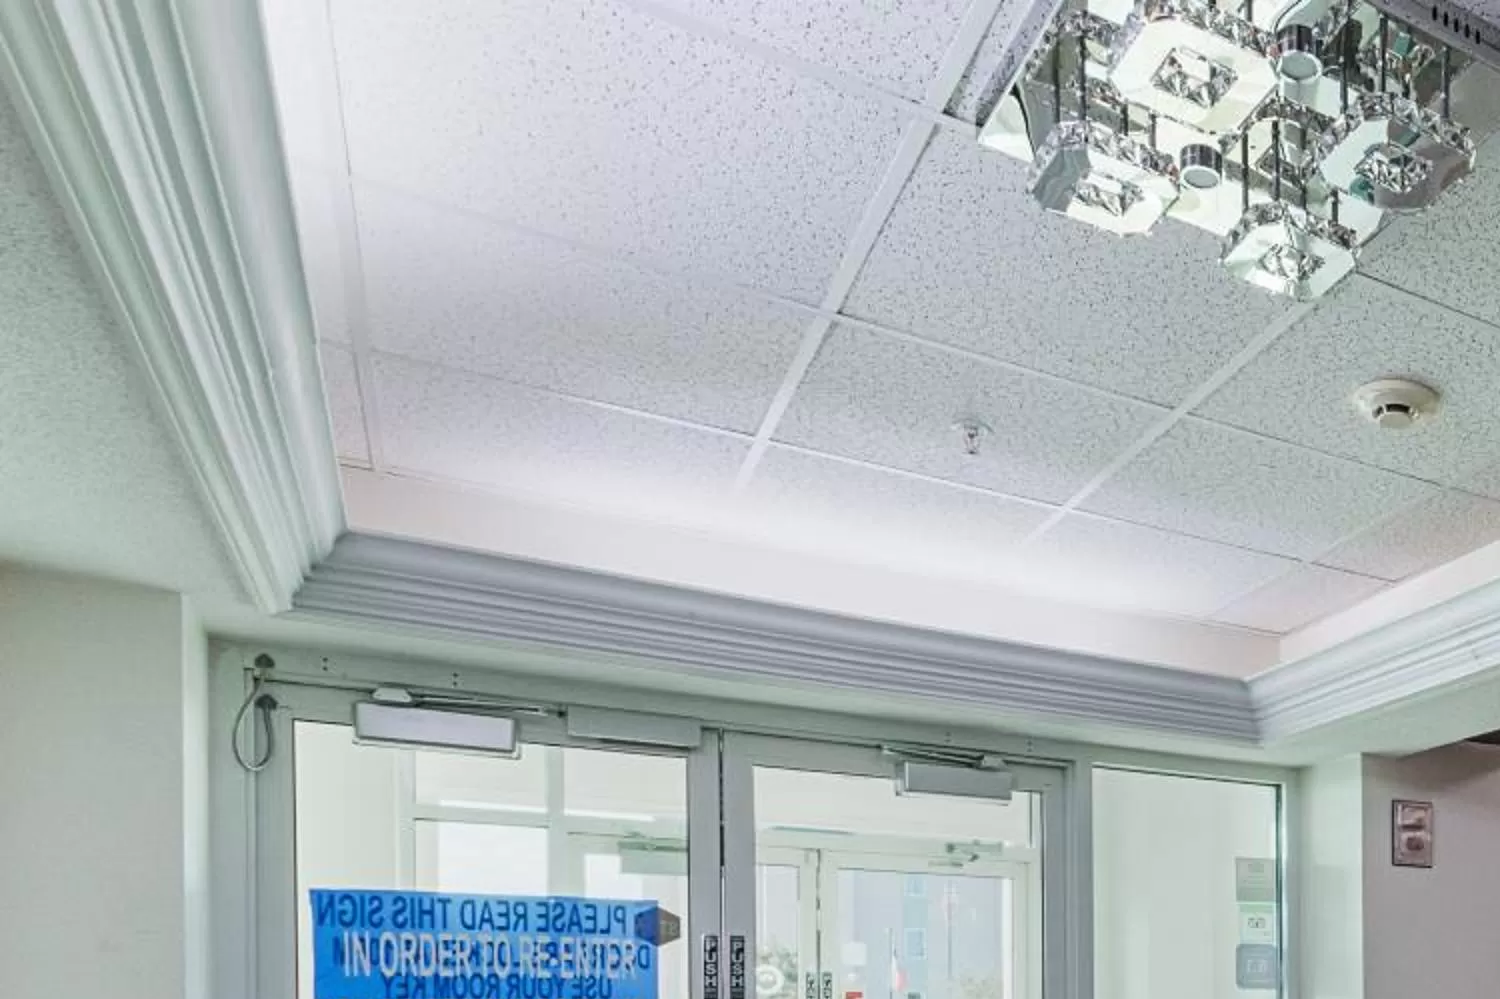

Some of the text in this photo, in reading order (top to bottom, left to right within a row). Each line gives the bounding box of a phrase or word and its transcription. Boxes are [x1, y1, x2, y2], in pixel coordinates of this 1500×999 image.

[343, 931, 371, 977] IN
[379, 932, 471, 978] ORDER
[477, 933, 511, 979] TO
[519, 935, 636, 981] RE-ENTER
[705, 940, 717, 987] PUSH
[731, 940, 743, 987] PUSH
